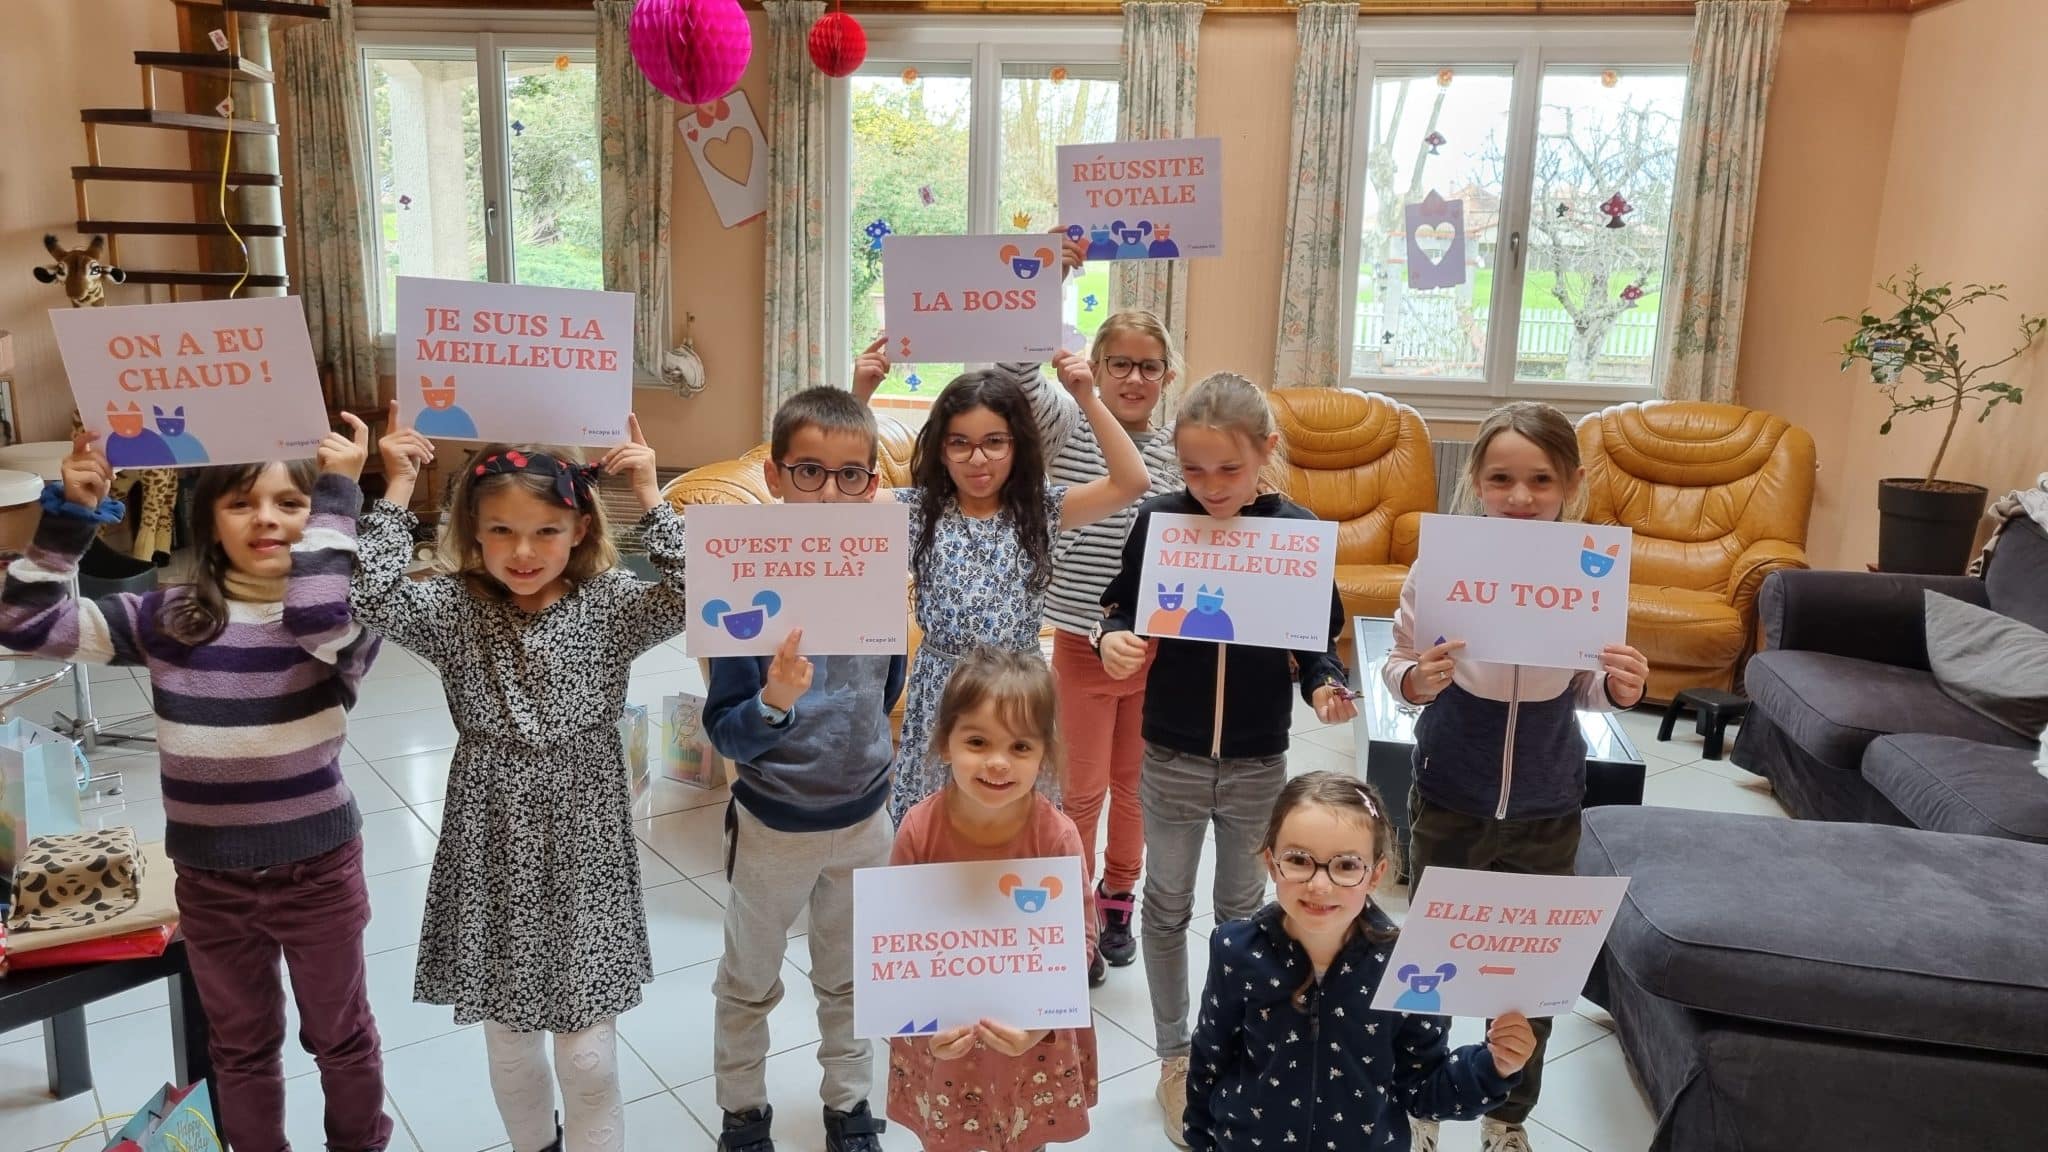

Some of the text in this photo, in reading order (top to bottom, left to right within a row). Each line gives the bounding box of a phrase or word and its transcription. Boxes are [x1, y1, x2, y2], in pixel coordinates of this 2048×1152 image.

[1072, 155, 1204, 182] RÉUSSITE
[1086, 184, 1196, 208] TOTALE
[911, 288, 1038, 313] LA BOSS
[425, 308, 605, 341] JE SUIS LA
[108, 327, 264, 360] ON A EU
[416, 339, 618, 372] MEILLEURE
[704, 537, 889, 558] QU'EST CE QUE
[1161, 527, 1320, 553] ON EST LES
[731, 555, 866, 582] JE FAIS LÀ?
[1157, 550, 1318, 578] MEILLEURS
[1446, 580, 1499, 604] AU
[1424, 902, 1604, 926] ELLE N'A RIEN
[871, 926, 1065, 954] PERSONNE NE
[1450, 933, 1562, 953] COMPRIS
[871, 960, 921, 981] M'A
